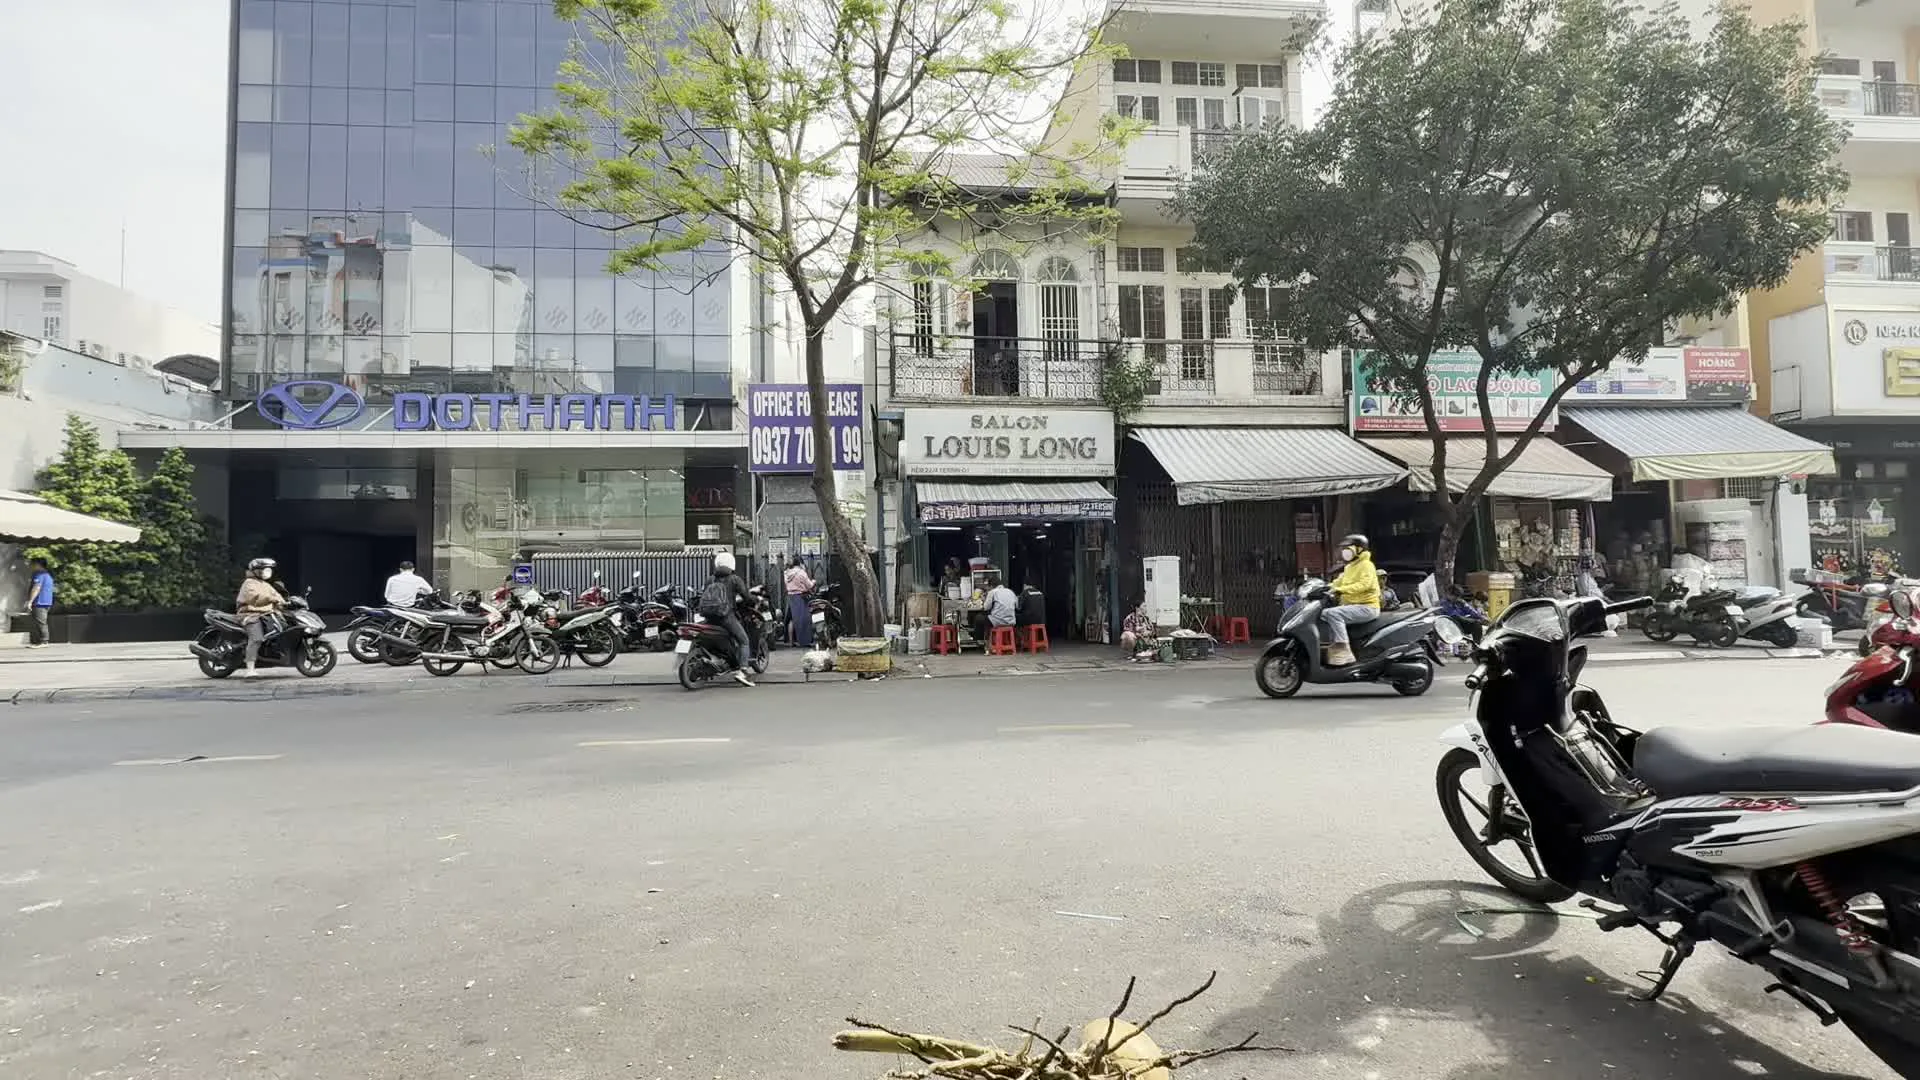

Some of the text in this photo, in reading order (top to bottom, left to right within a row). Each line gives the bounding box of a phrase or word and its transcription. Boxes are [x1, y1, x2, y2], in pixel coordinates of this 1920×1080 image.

[393, 393, 675, 430] DOTHANH
[753, 391, 858, 417] OFFICE FO EASE
[970, 414, 1048, 430] SALON
[752, 426, 790, 465] 0937
[842, 425, 862, 464] 99
[924, 436, 1097, 459] LOUIS LONG
[1583, 833, 1617, 844] HONDA
